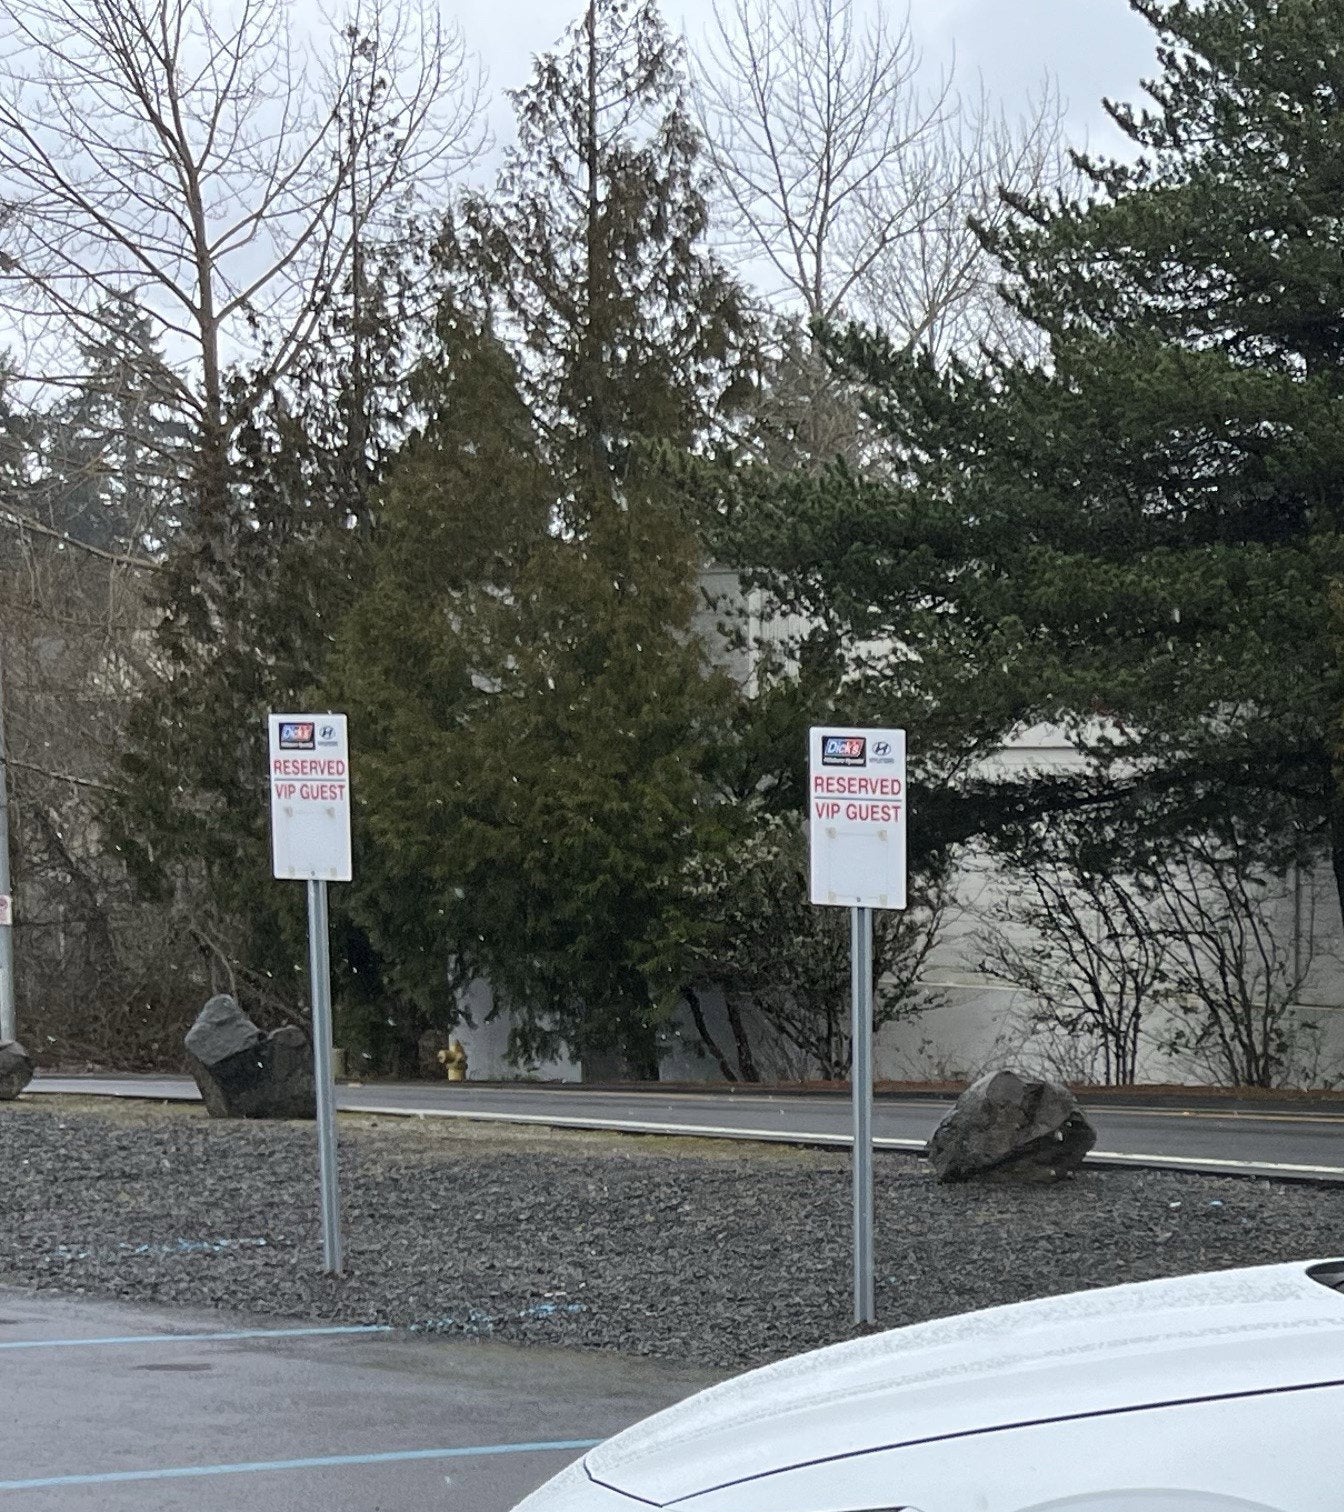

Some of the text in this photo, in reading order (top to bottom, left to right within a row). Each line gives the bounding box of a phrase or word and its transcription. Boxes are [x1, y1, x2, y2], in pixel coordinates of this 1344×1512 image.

[274, 759, 345, 776] RESERVED
[275, 783, 346, 801] VIP GUEST
[814, 776, 902, 795] RESERVED
[815, 802, 902, 823] VIP GUEST
